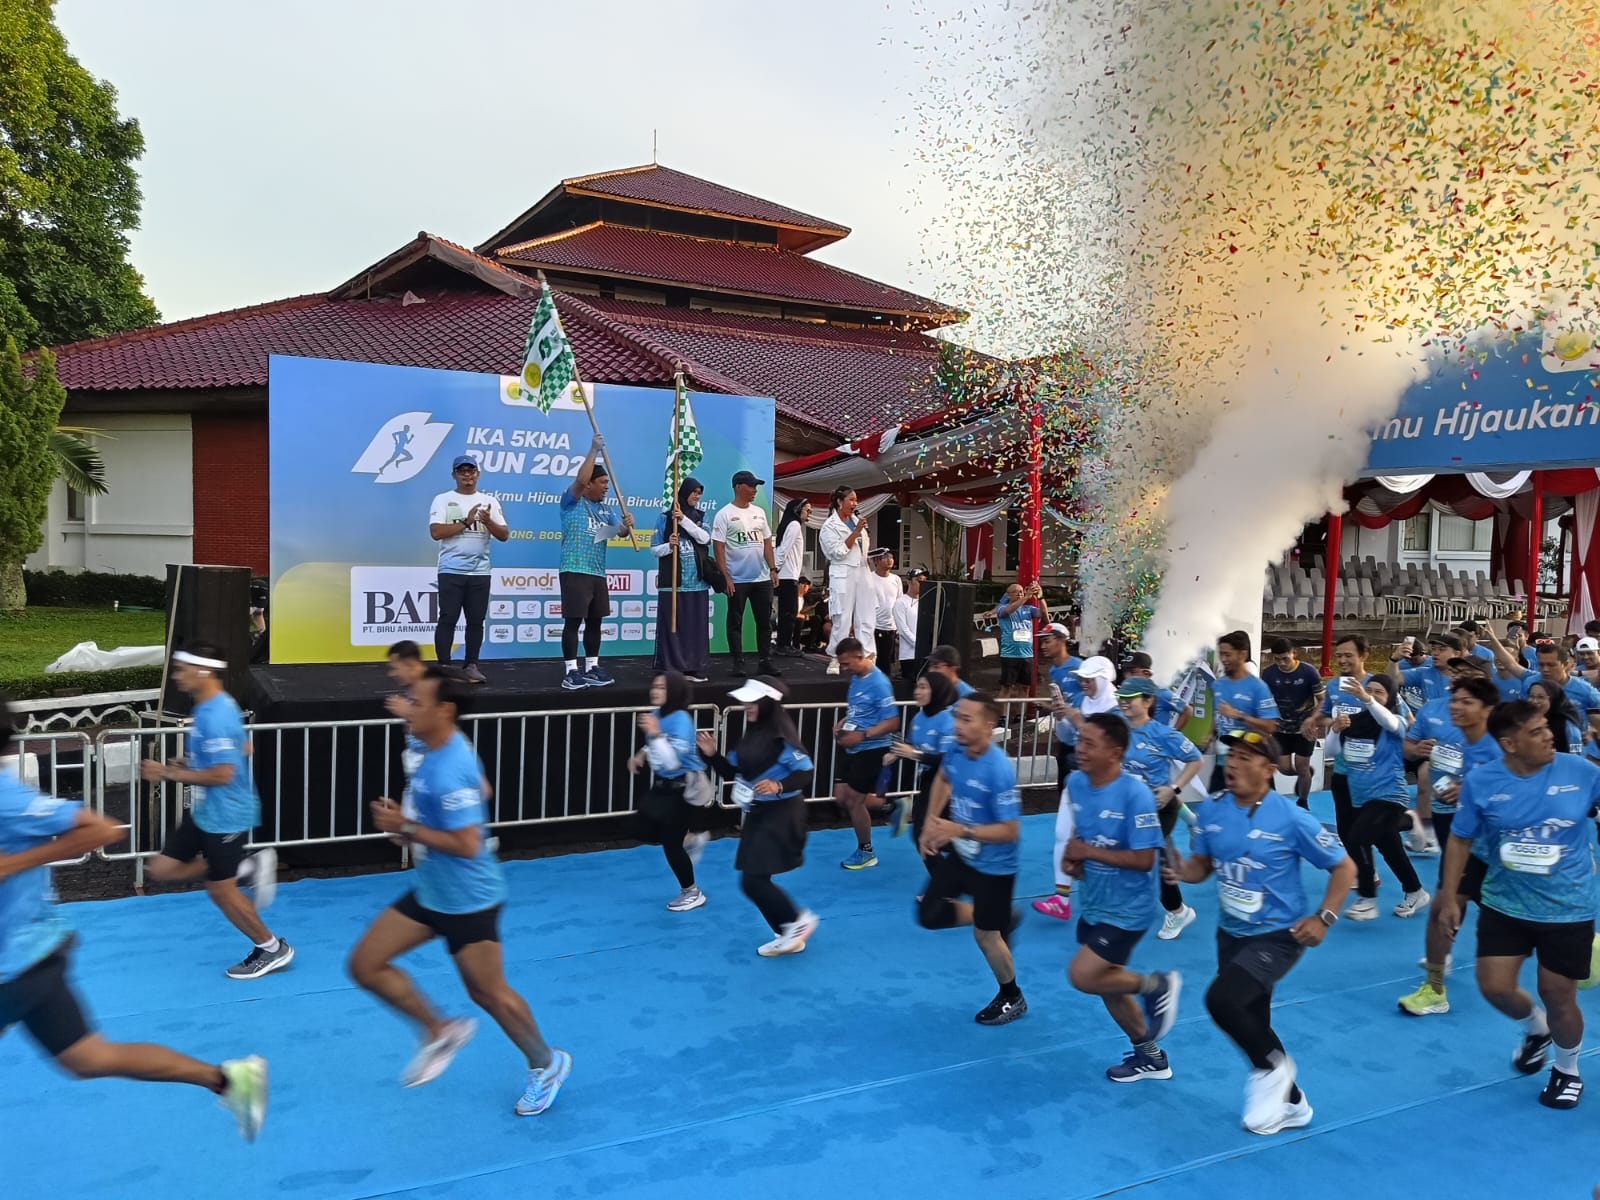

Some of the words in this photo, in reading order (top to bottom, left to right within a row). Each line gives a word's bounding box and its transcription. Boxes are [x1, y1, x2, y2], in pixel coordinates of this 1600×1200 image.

[1371, 416, 1424, 441] mu
[1432, 398, 1600, 442] Hijaukan
[466, 426, 505, 447] IKA
[510, 429, 571, 450] 5KMA
[530, 453, 604, 478] 202
[527, 490, 562, 507] Hijau
[538, 530, 563, 541] BOG
[500, 572, 558, 588] wondr
[362, 590, 439, 625] BAT
[362, 625, 375, 634] PT.
[376, 625, 396, 634] BIRU
